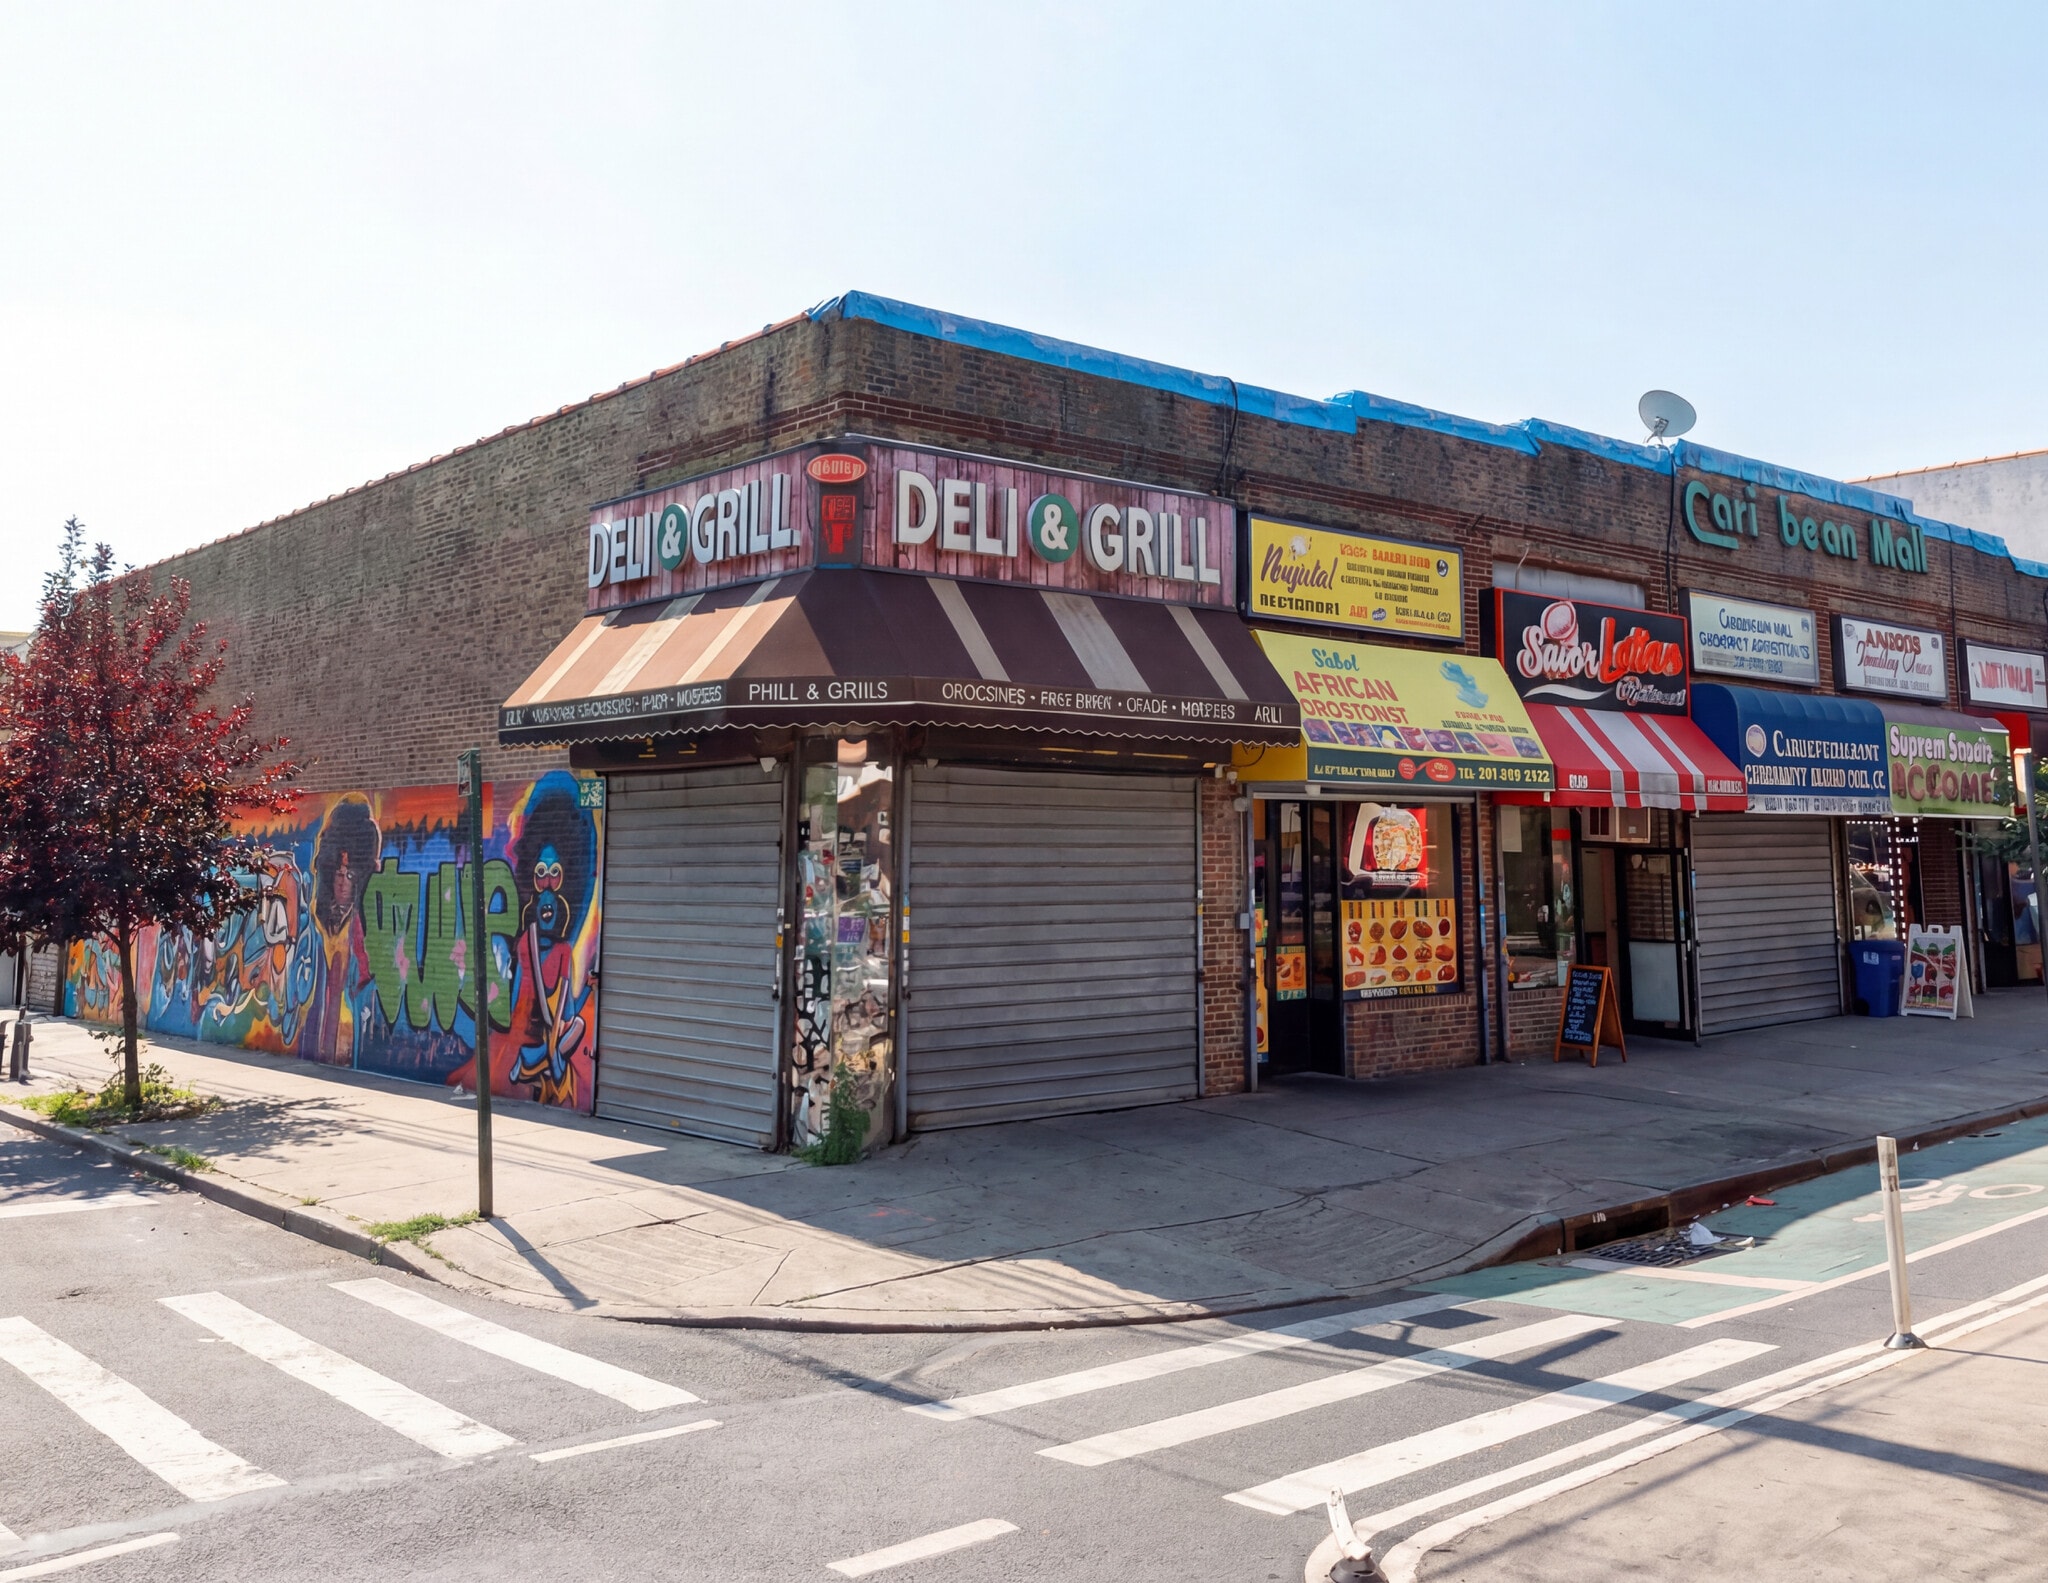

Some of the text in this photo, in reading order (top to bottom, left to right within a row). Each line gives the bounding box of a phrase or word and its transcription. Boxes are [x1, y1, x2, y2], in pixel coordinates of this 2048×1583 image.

[588, 512, 660, 588] DELI
[691, 473, 799, 565] GRILL
[893, 469, 1018, 558] DELI
[1083, 502, 1221, 585] GRILL
[1682, 480, 1928, 574] Cari bean Mall
[749, 682, 799, 702] PHILL
[807, 682, 821, 701] &
[942, 682, 1026, 706] OROCSINES
[1293, 671, 1399, 702] AFRICAN
[1299, 697, 1409, 724] OROSTONST
[1478, 767, 1498, 781] 201
